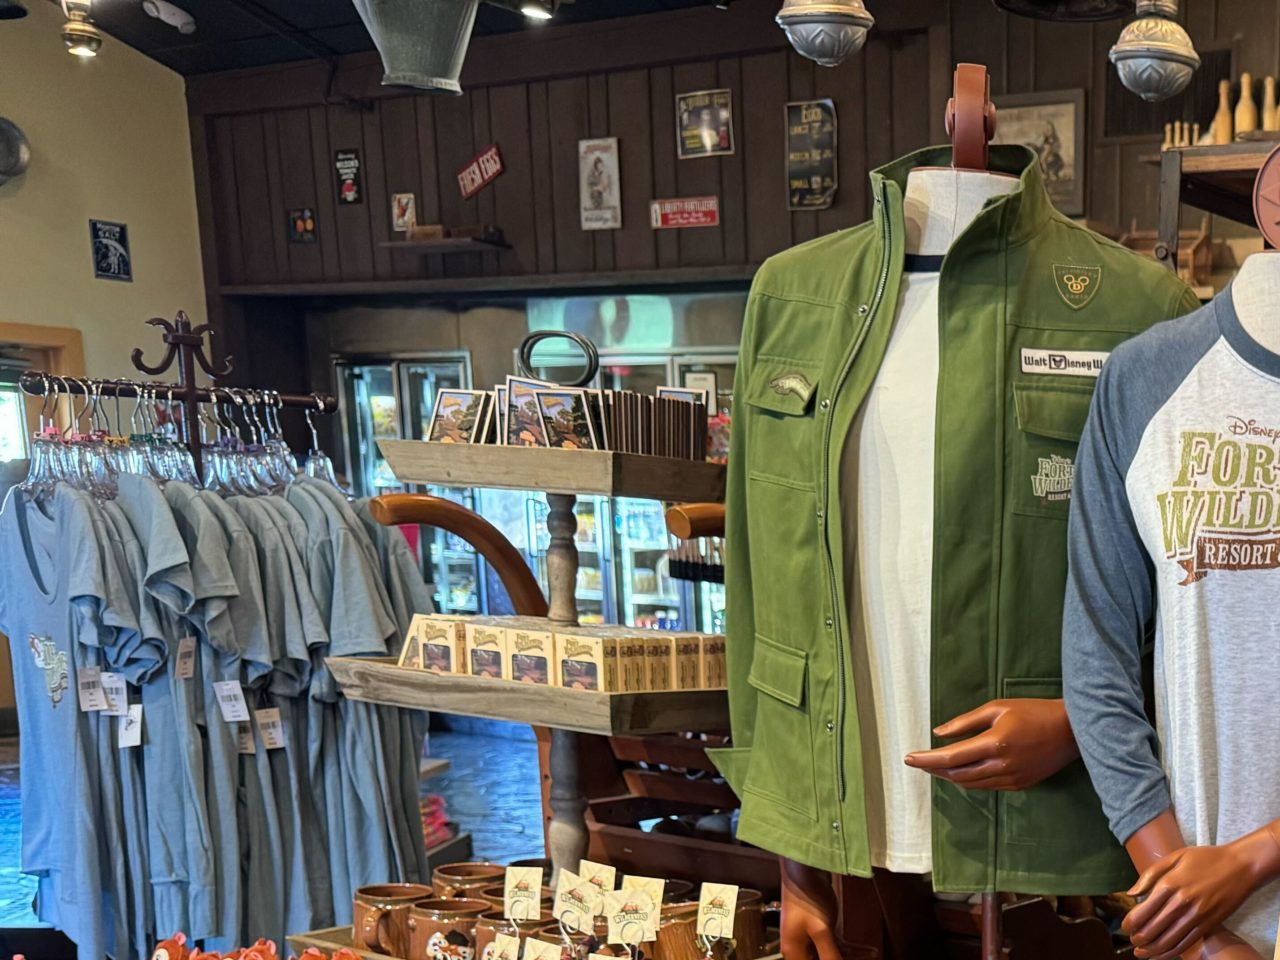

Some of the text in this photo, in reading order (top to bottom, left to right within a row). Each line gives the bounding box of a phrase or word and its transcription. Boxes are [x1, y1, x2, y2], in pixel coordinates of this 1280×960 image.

[458, 147, 502, 197] FRESH EGGS
[1024, 356, 1048, 367] Walt
[1031, 474, 1072, 496] WILDE
[1203, 542, 1275, 565] RESORT
